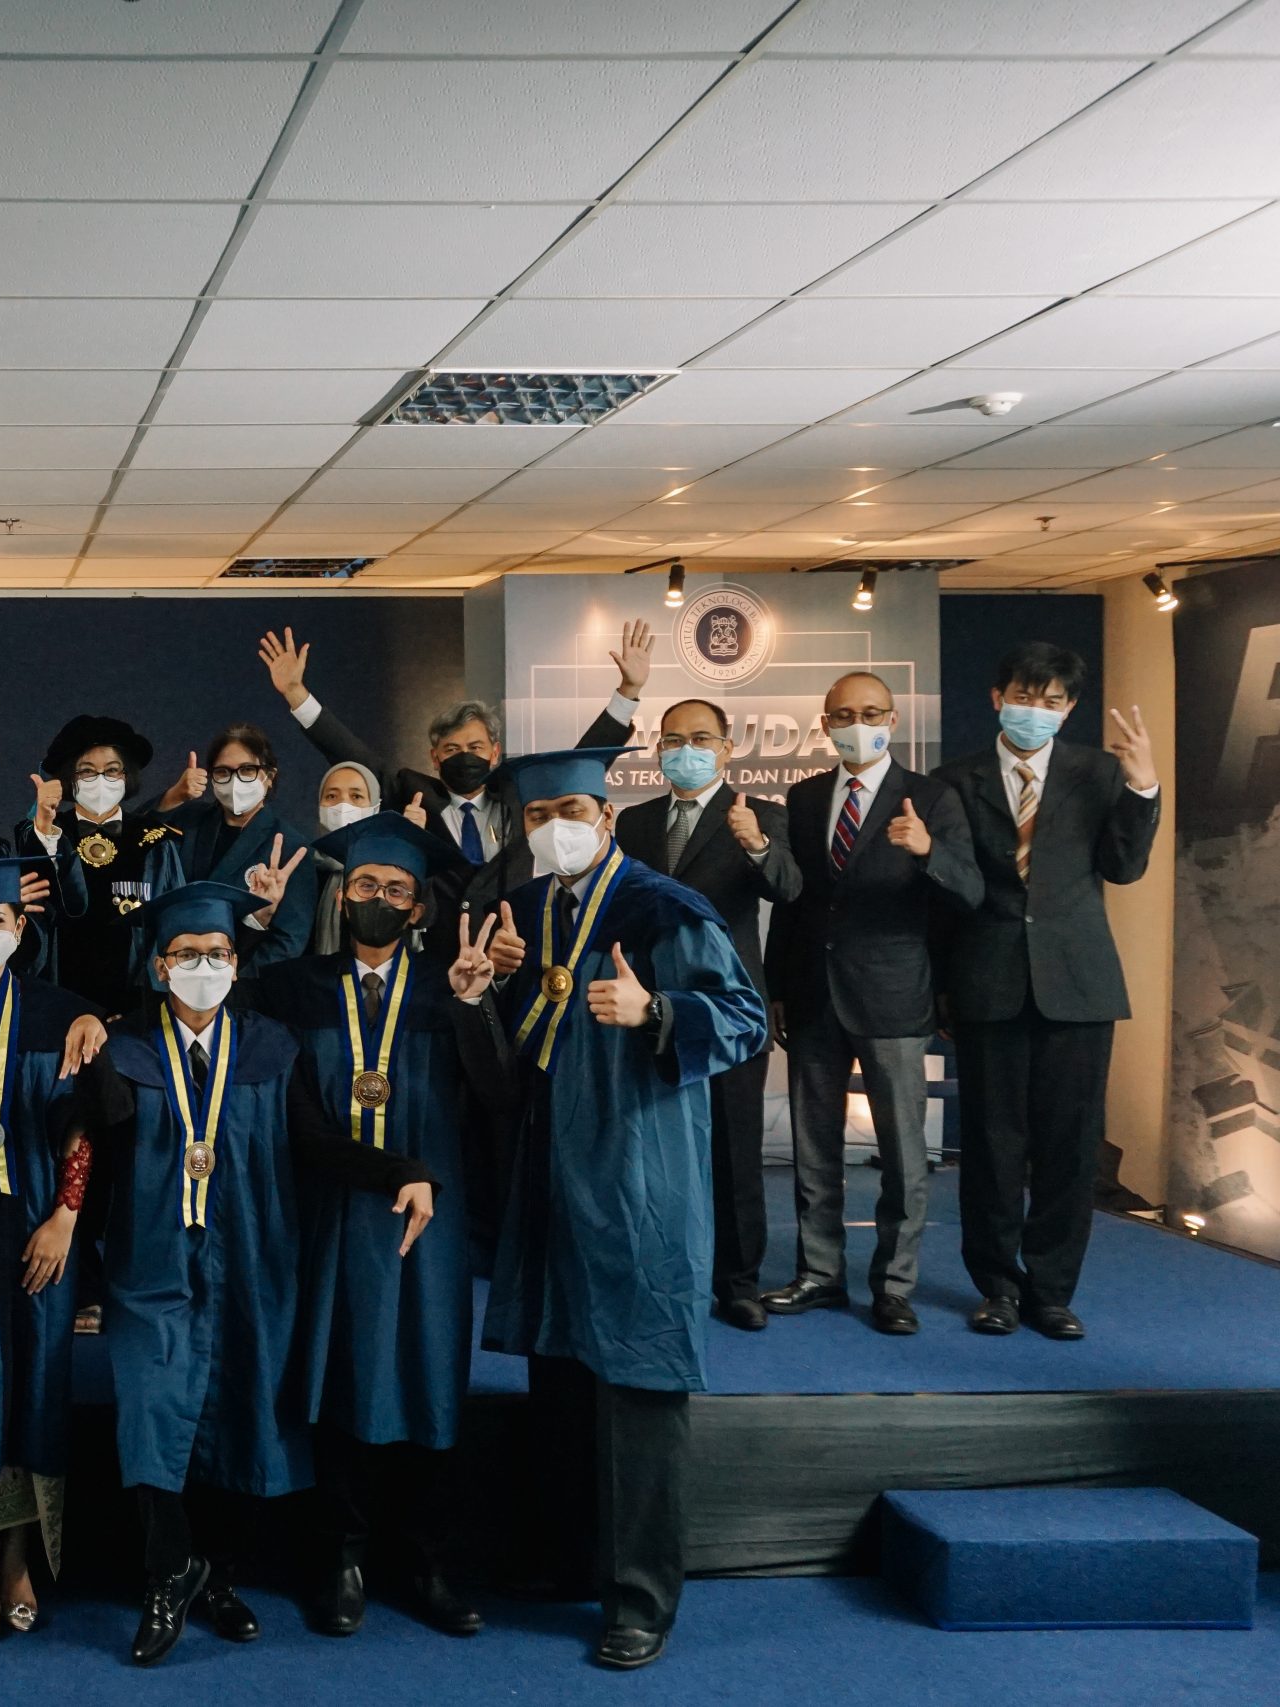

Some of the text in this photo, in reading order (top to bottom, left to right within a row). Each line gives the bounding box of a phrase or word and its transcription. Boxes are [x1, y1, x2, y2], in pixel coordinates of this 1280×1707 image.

[691, 595, 754, 617] TEKNOLOGI
[684, 619, 704, 668] INSTITUT
[713, 669, 737, 677] 1920
[740, 769, 779, 784] DAN
